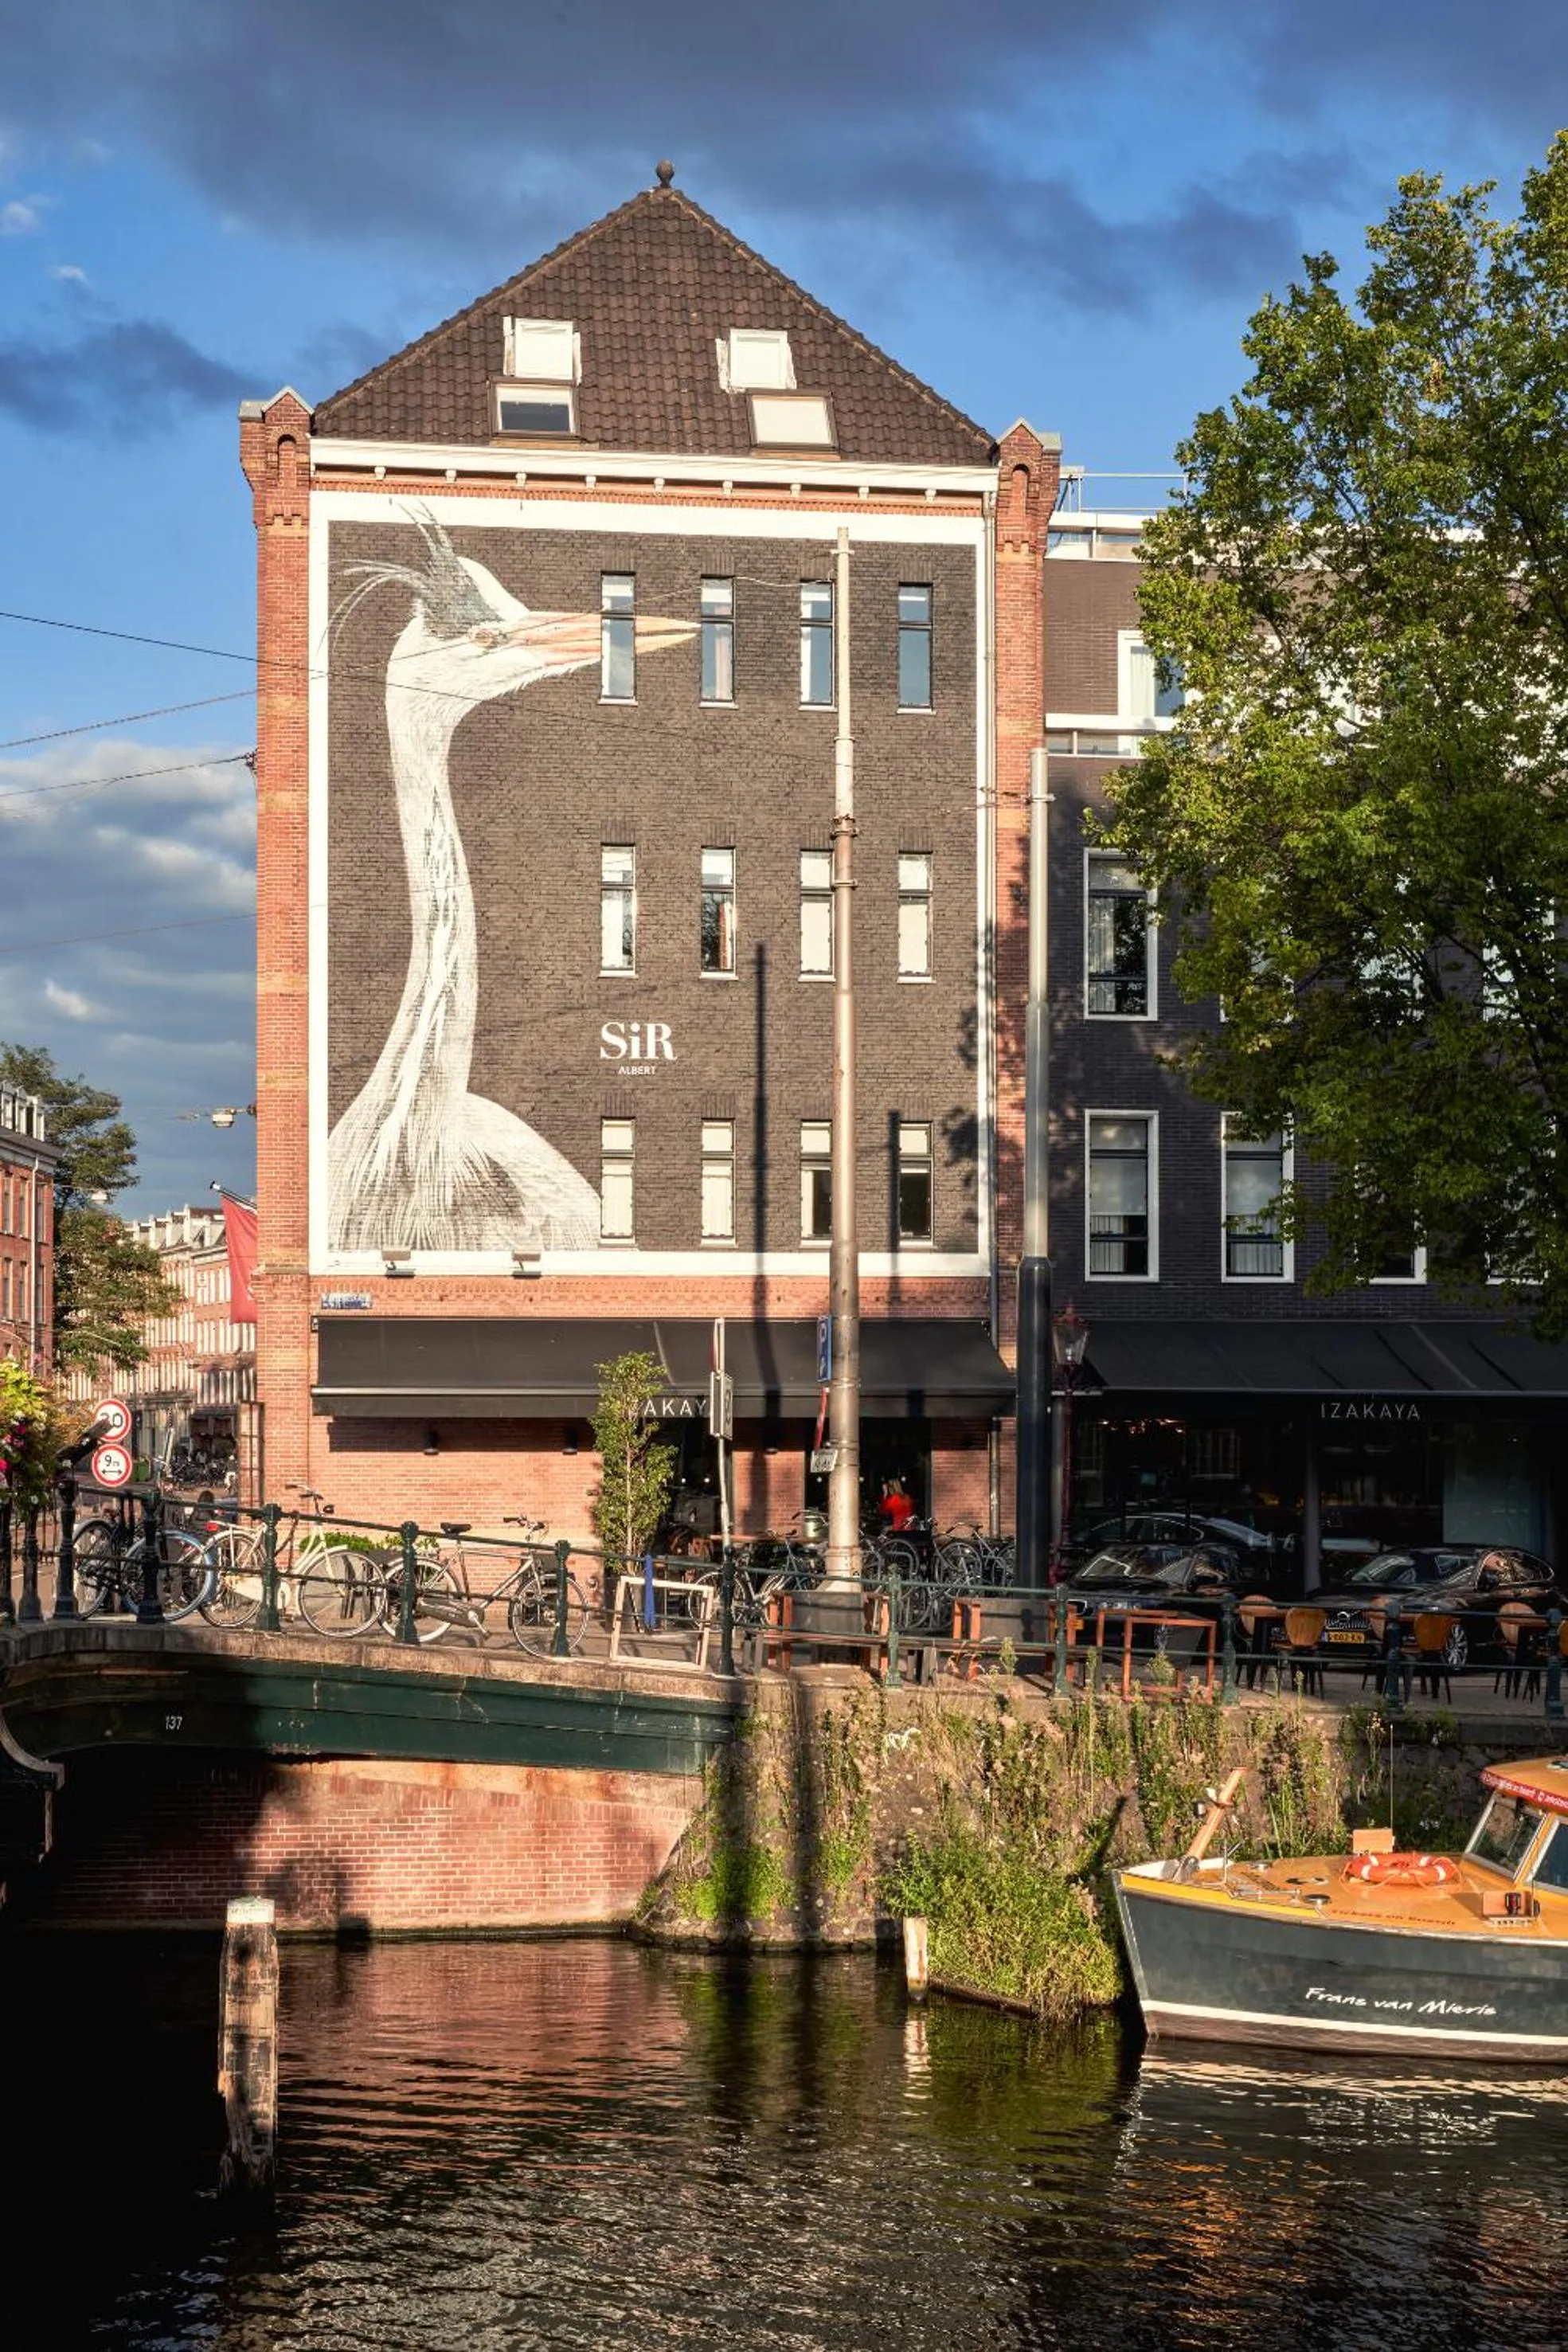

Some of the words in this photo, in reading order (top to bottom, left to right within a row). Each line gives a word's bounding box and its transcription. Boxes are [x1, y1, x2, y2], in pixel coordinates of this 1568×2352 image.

[600, 1021, 678, 1060] SiR
[618, 1066, 657, 1075] ALBERT
[643, 1399, 707, 1416] AKAY
[1320, 1402, 1421, 1420] IZAKAYA
[166, 1716, 183, 1730] 137
[1305, 1987, 1367, 2006] Frans
[1374, 1999, 1414, 2010] van
[1417, 2000, 1497, 2016] Mieris
